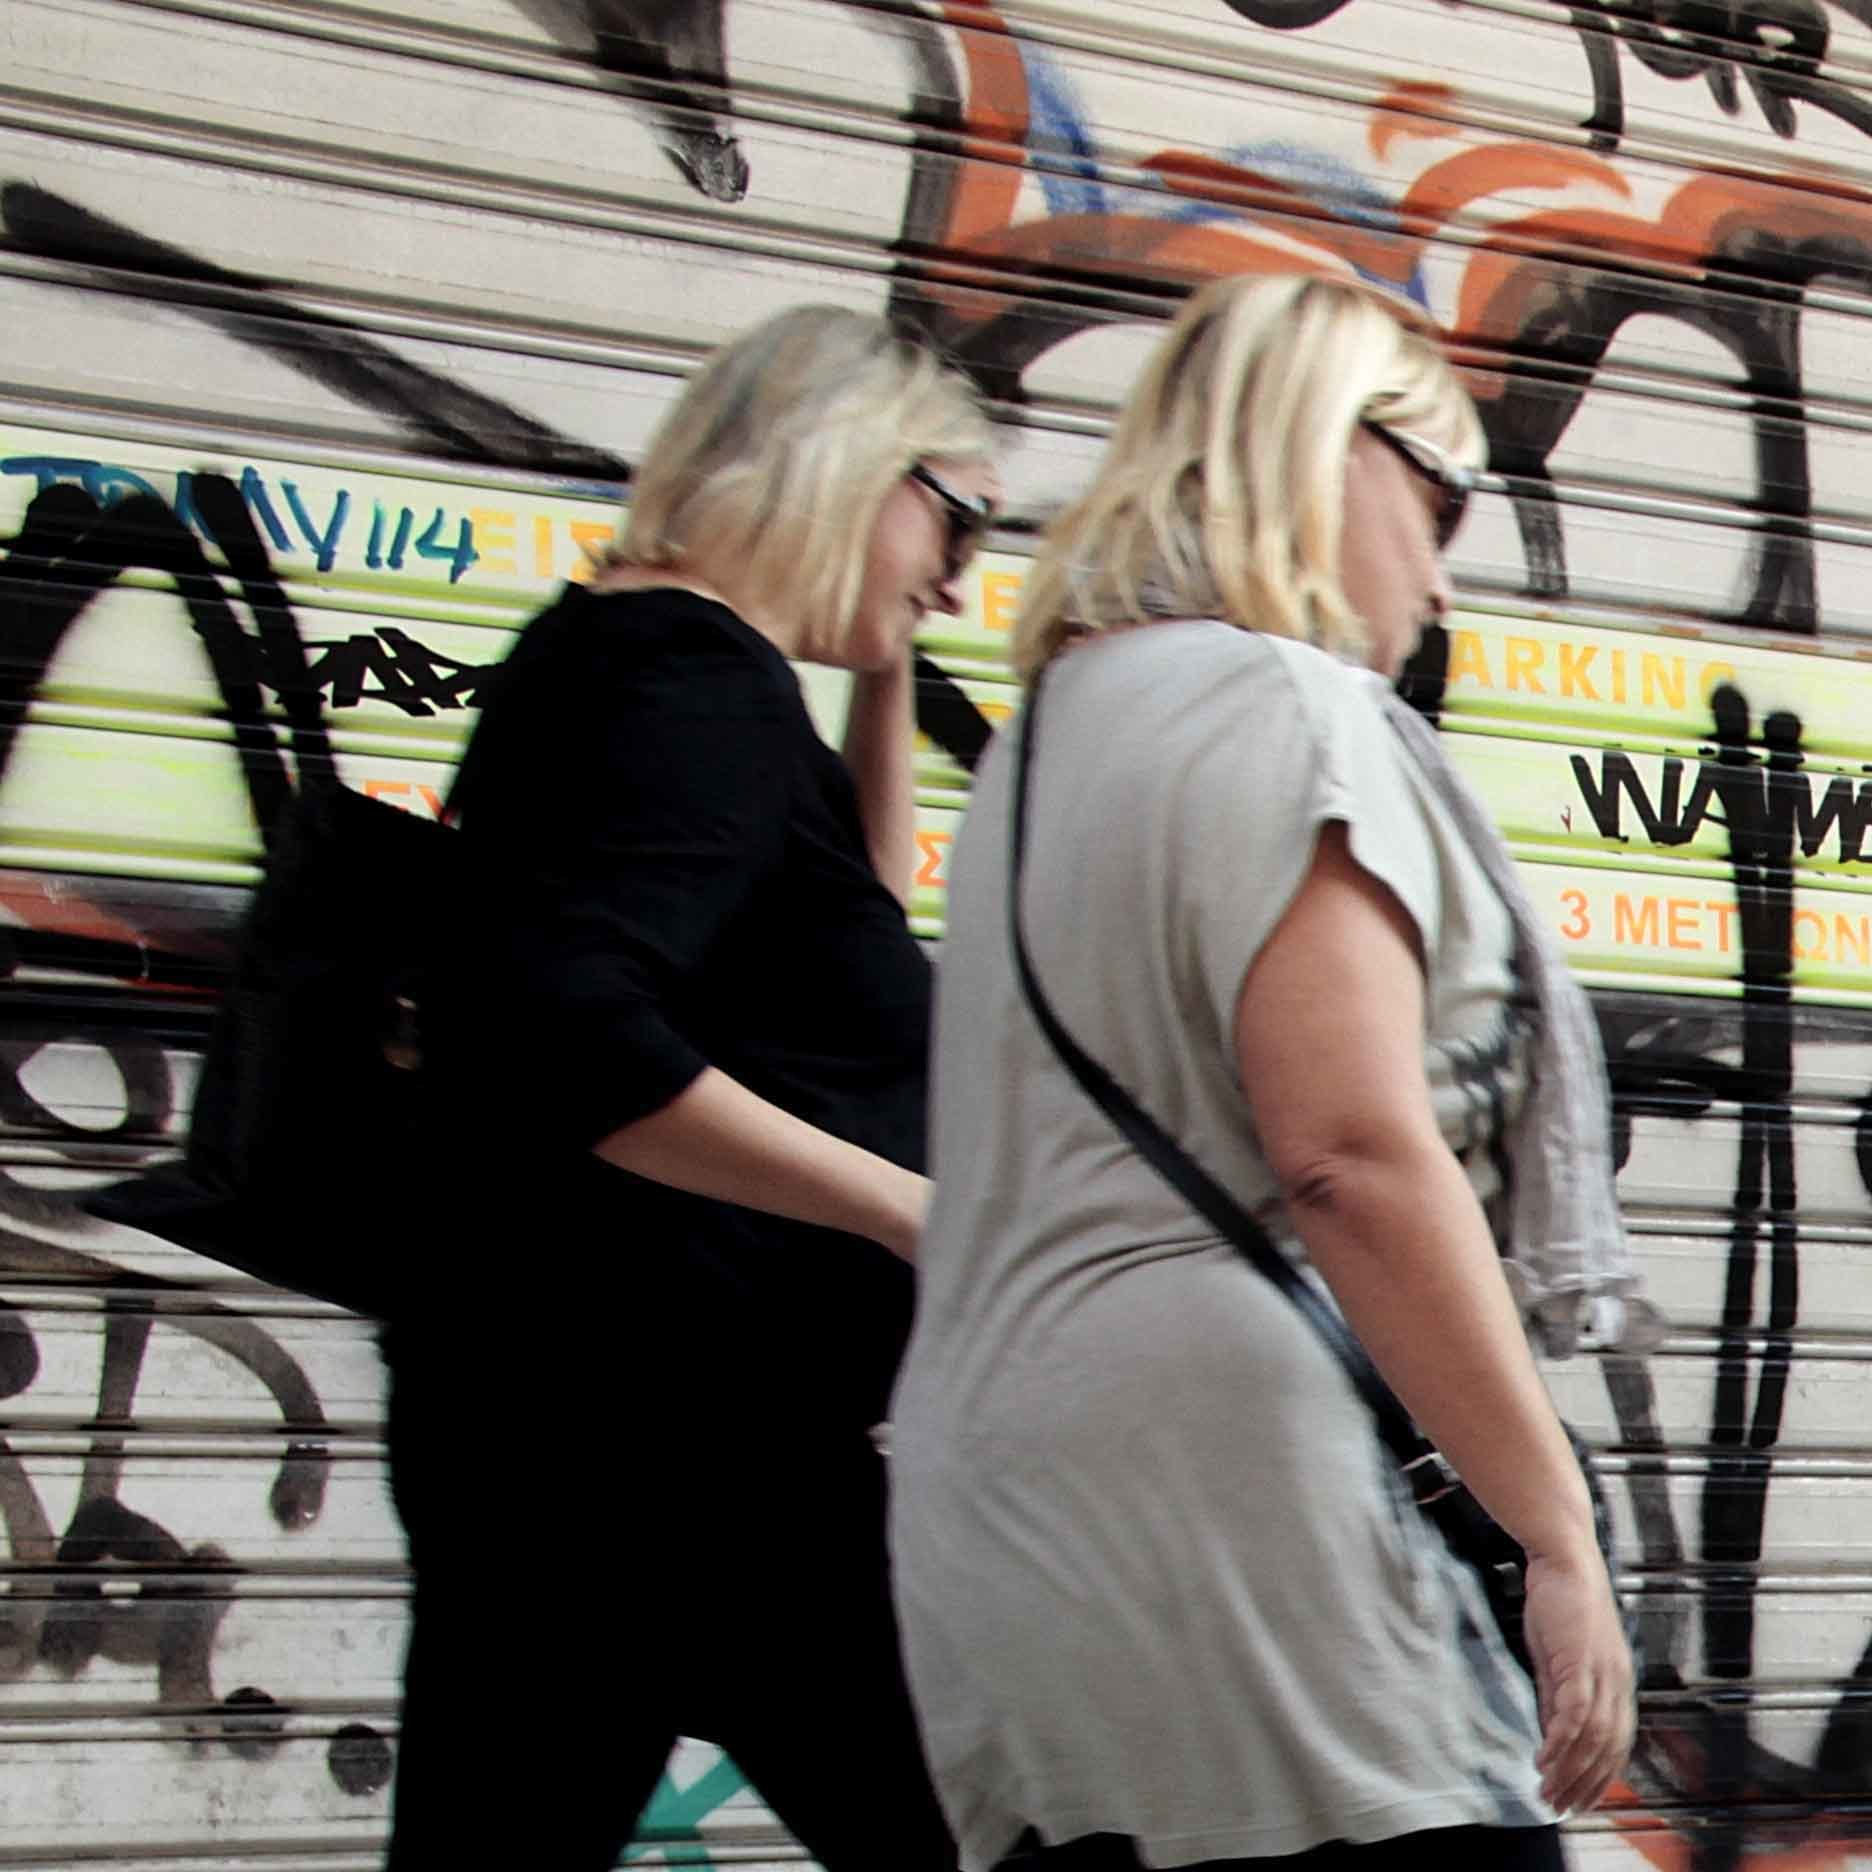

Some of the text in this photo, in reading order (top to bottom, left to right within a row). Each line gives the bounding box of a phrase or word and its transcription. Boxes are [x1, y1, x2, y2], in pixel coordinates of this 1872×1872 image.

[1446, 629, 1739, 711] ARKIN
[1559, 889, 1872, 965] 3 ΜΕΤΩΝ
